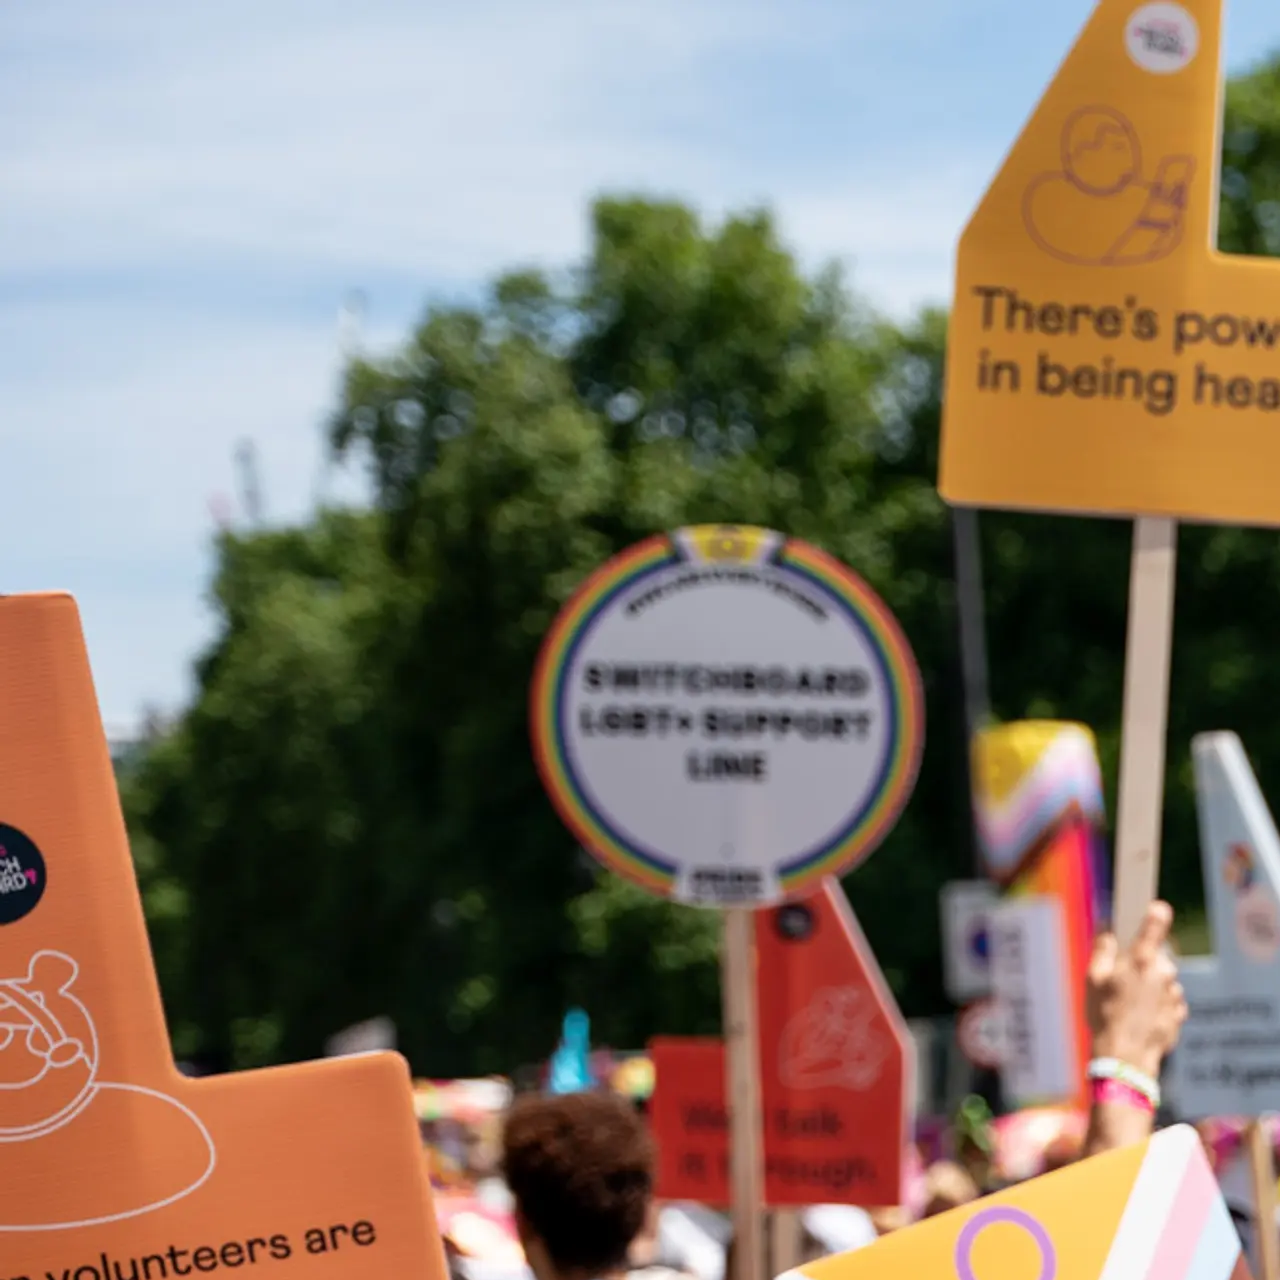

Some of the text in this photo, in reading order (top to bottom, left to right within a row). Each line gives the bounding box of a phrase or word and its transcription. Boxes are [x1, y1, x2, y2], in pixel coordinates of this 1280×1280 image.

[974, 286, 1158, 341] There's
[976, 349, 1020, 393] in
[1037, 352, 1176, 417] being
[685, 750, 768, 783] LINE
[304, 1221, 377, 1254] are
